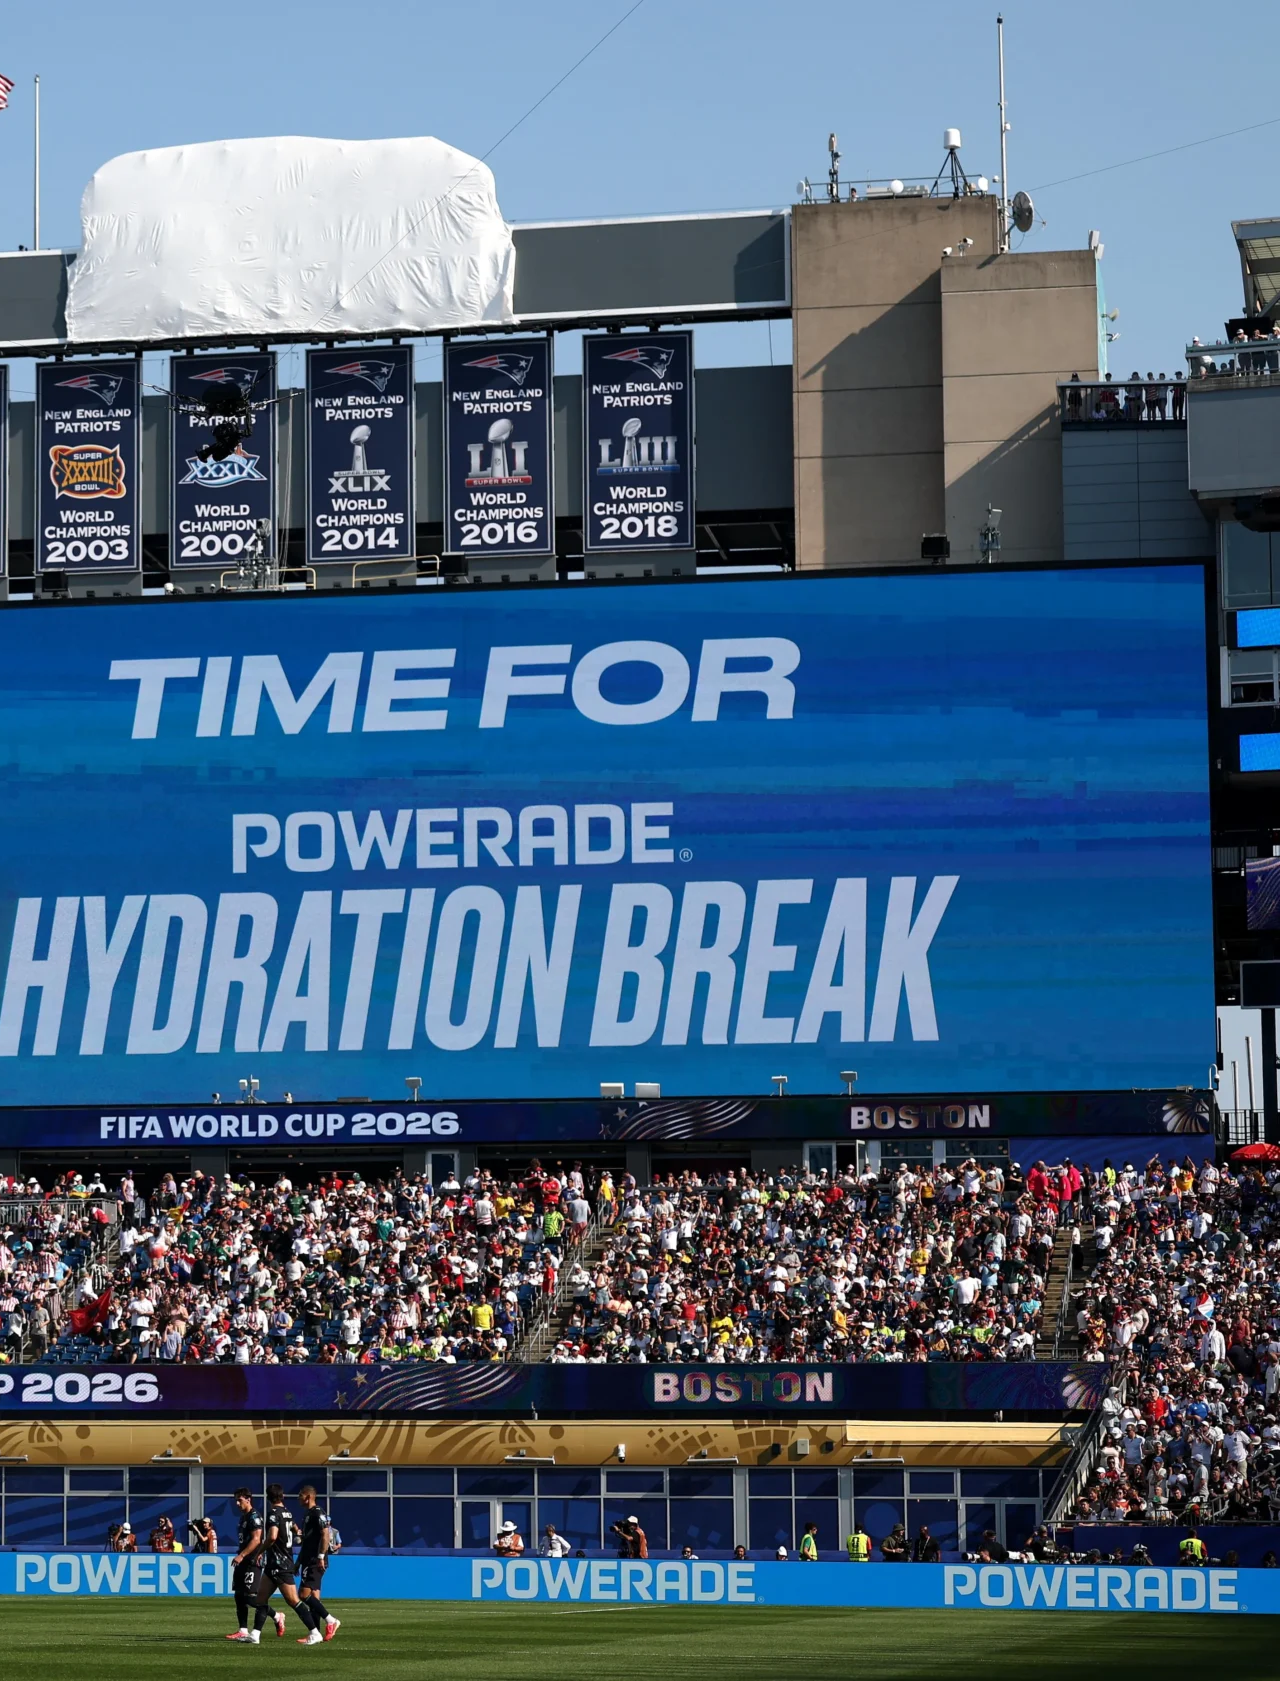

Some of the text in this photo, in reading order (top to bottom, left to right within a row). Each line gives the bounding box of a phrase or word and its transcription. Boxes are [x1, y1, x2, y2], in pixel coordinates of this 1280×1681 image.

[453, 388, 543, 401] NEW ENGLAND
[592, 382, 683, 394] NEW ENGLAND
[315, 395, 404, 408] NEW ENGLAND
[463, 401, 532, 414] PATRIOTS
[603, 394, 672, 408] PATRIOTS
[45, 409, 131, 421] NEW ENGLAND
[189, 414, 256, 427] PATROTS
[325, 407, 393, 421] PATRIOTS
[55, 421, 121, 434] PATRIOTS
[61, 456, 114, 487] XXXVIII
[75, 483, 100, 491] BOWL
[328, 475, 391, 493] XLIX
[470, 492, 526, 505] WORLD
[609, 486, 666, 499] WORLD
[195, 504, 250, 517] WORLD
[331, 498, 387, 511] WORLD
[593, 501, 684, 515] CHAMPIONS
[60, 510, 114, 523] WORLD
[316, 513, 404, 527] CHAMPIONS
[454, 507, 543, 521] CHAMPIONS
[44, 525, 130, 539] CHAMPIONS
[179, 519, 261, 533] CHAMPION
[600, 515, 678, 540] 2018
[321, 527, 399, 551] 2014
[460, 521, 538, 546] 2016
[45, 539, 129, 563] 2003
[181, 534, 264, 558] 2004
[108, 636, 801, 740] TIME FOR
[232, 801, 674, 874] POWERADE
[588, 874, 961, 1047] BREAK
[850, 1104, 991, 1130] BOSTON
[100, 1111, 459, 1139] FIFA WORLD CUP 2026
[21, 1372, 159, 1402] 2026
[653, 1371, 834, 1402] BOSTON
[16, 1554, 283, 1594] POWERA
[244, 1571, 254, 1583] 23
[472, 1559, 756, 1602] POWERADE
[944, 1565, 1238, 1611] POWERADE
